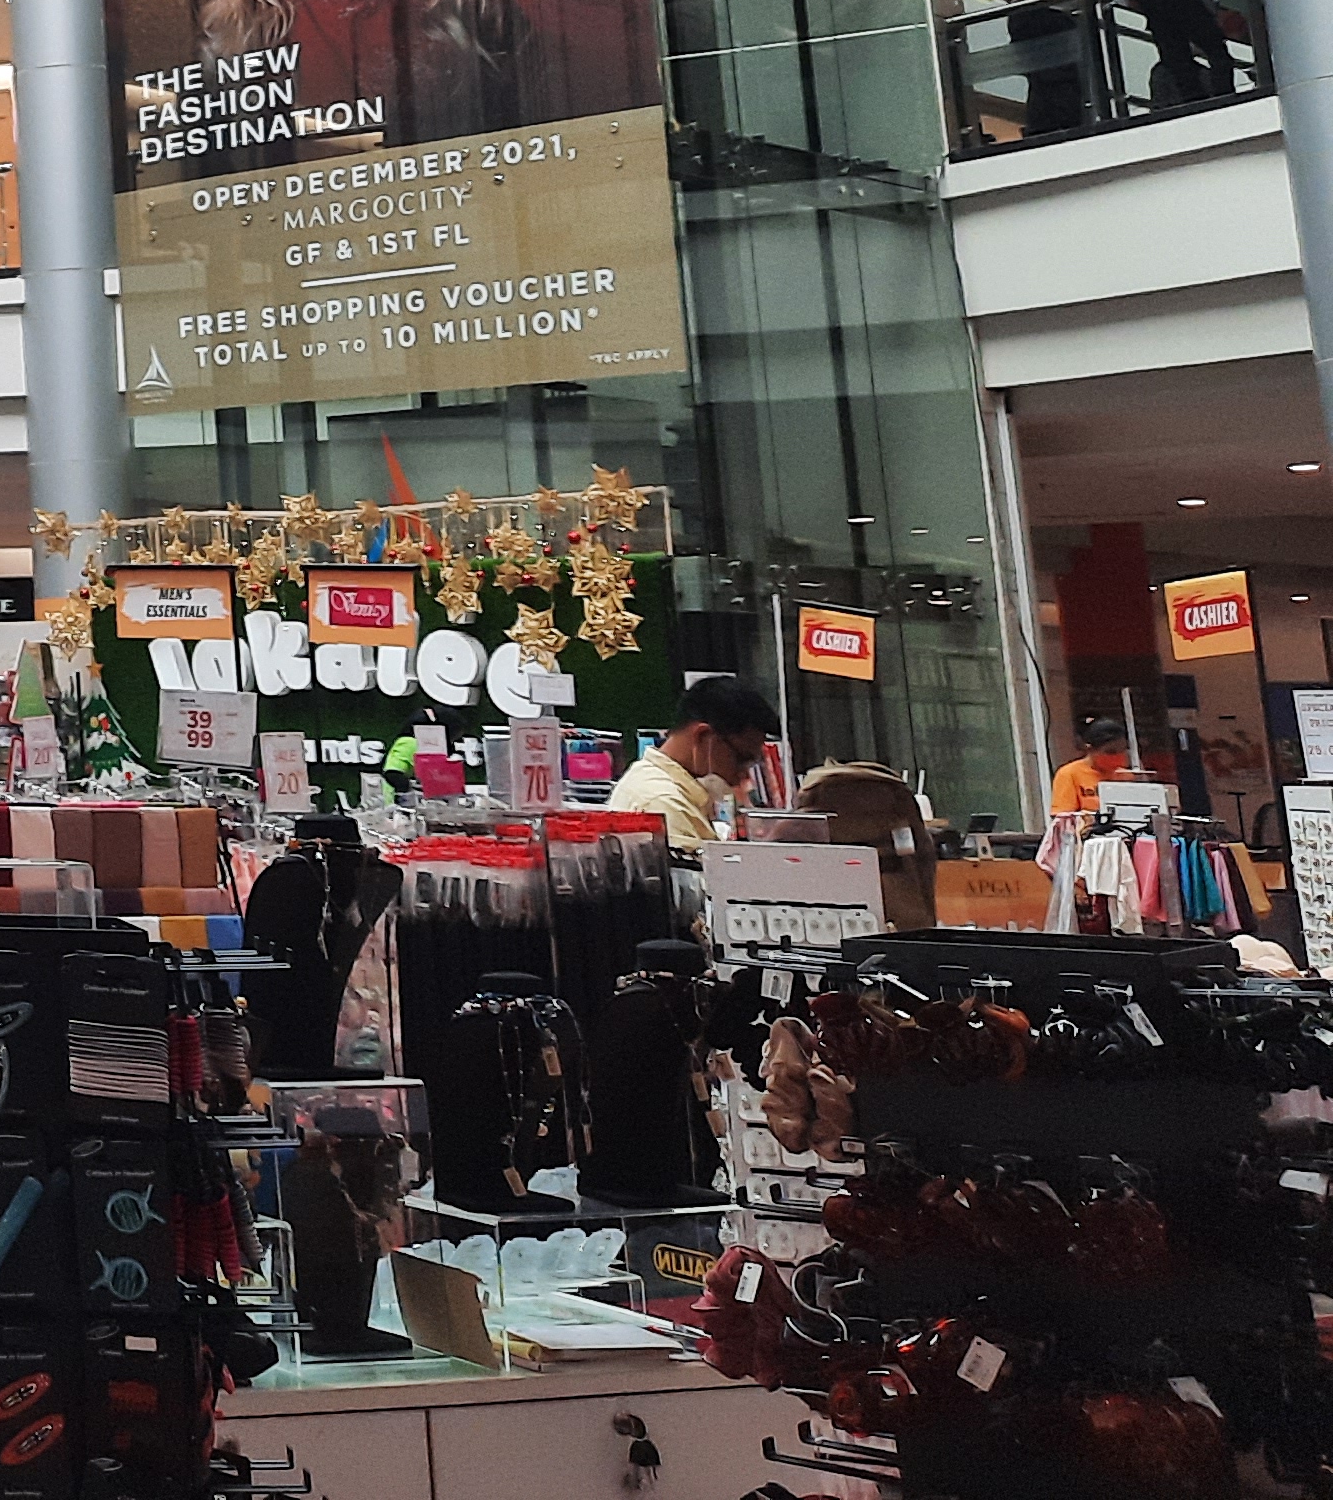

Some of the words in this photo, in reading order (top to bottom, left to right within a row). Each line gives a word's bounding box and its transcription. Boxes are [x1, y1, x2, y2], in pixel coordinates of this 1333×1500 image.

[134, 62, 204, 100] THE
[217, 43, 301, 84] NEW
[138, 78, 294, 132] FASHION
[140, 97, 384, 164] DESTINATION
[192, 180, 271, 212] OPEN
[285, 150, 464, 198] DECEMBER
[481, 133, 577, 169] 2021,
[283, 185, 466, 232] MARGOCITY
[285, 242, 322, 267] GF
[336, 238, 354, 261] &
[367, 229, 418, 255] 1ST
[434, 224, 470, 248] FL
[177, 310, 248, 339] FREE
[261, 290, 425, 330] SHOPPING
[441, 268, 616, 310] VOUCHER
[194, 339, 287, 368] TOTAL
[302, 343, 327, 358] UP
[339, 338, 366, 354] TO
[381, 325, 417, 350] 10
[145, 604, 208, 618] ESSENTIALS
[158, 587, 193, 601] MEN'S
[1184, 600, 1239, 631] CASHIER
[811, 629, 861, 654] CASHIER
[186, 709, 213, 729] 39
[186, 730, 214, 749] 99
